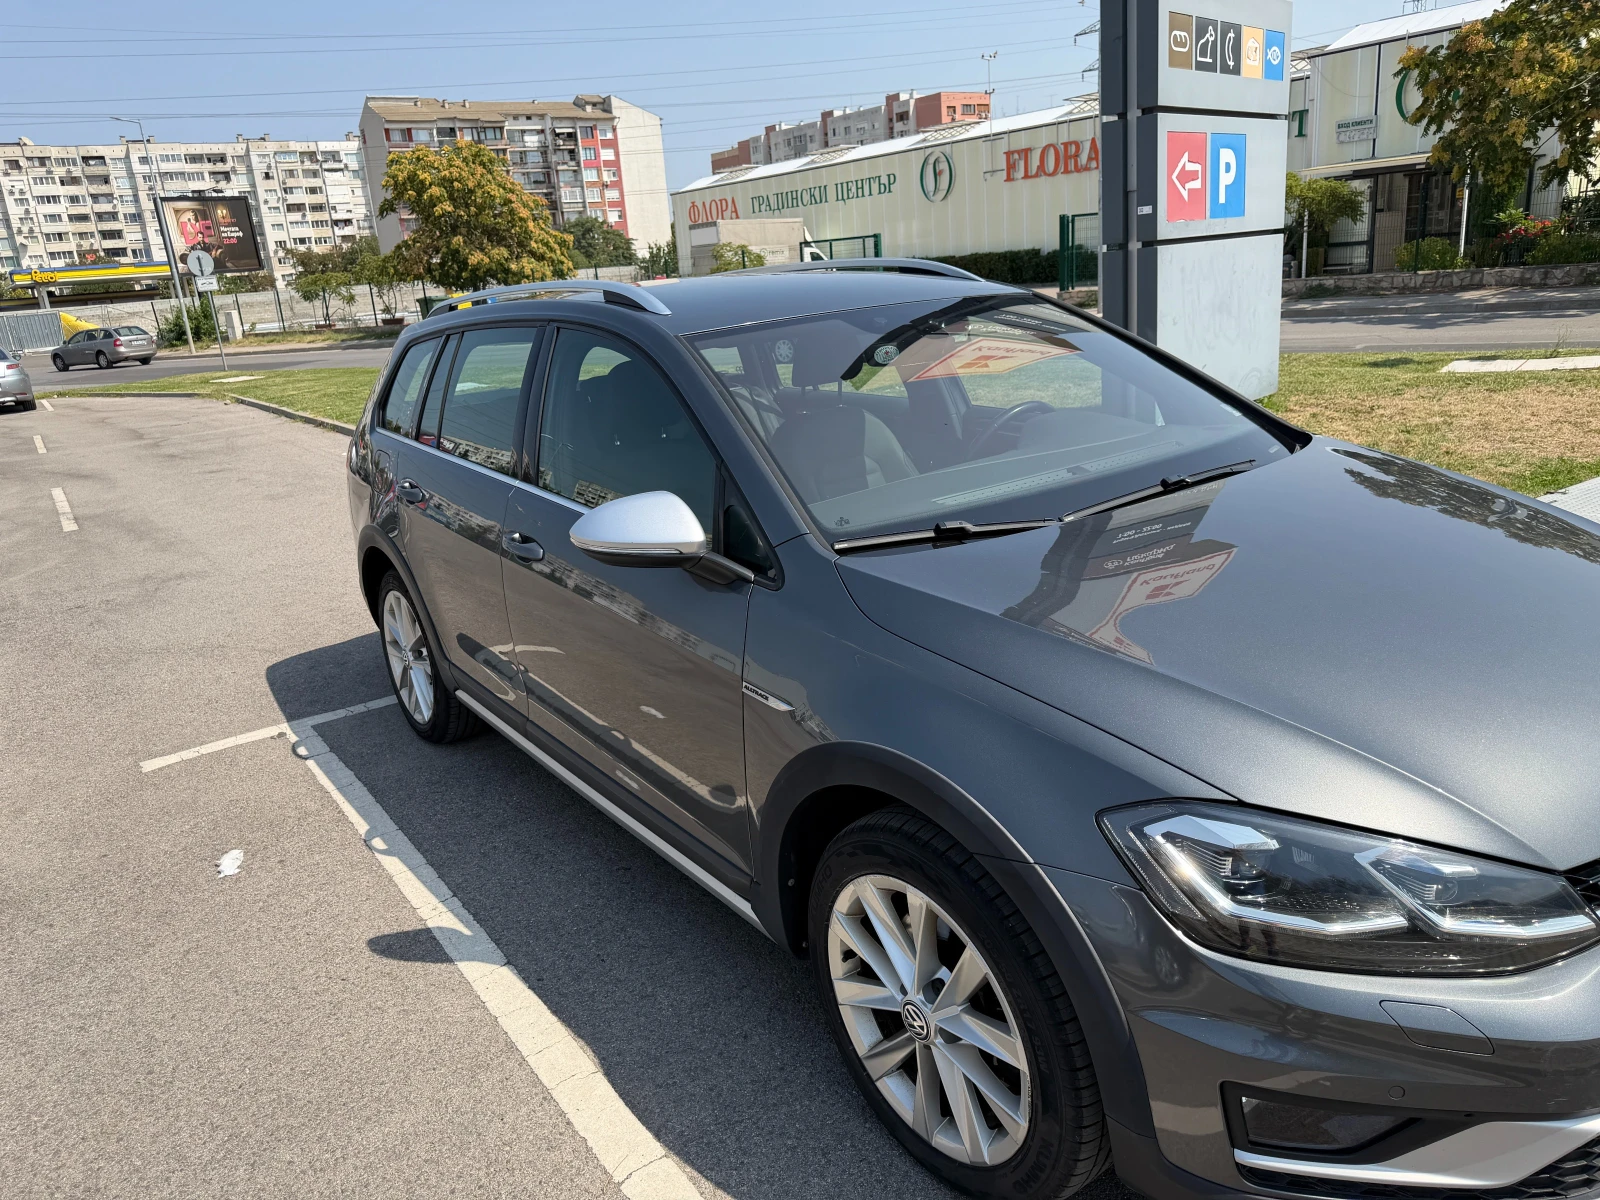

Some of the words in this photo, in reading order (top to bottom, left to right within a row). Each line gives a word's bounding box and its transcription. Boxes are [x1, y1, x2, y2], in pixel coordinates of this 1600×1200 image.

[1337, 122, 1351, 130] ВХОД
[1351, 118, 1374, 127] КЛИЕНТИ
[1003, 136, 1100, 182] FLORA
[1219, 147, 1236, 204] P
[688, 196, 740, 223] ФЛОРА
[751, 184, 828, 215] ГРАДИНСКИ
[834, 173, 896, 205] ЦЕНТЪР
[743, 684, 770, 702] ALLTRACK
[1011, 1135, 1055, 1194] KUMHO
